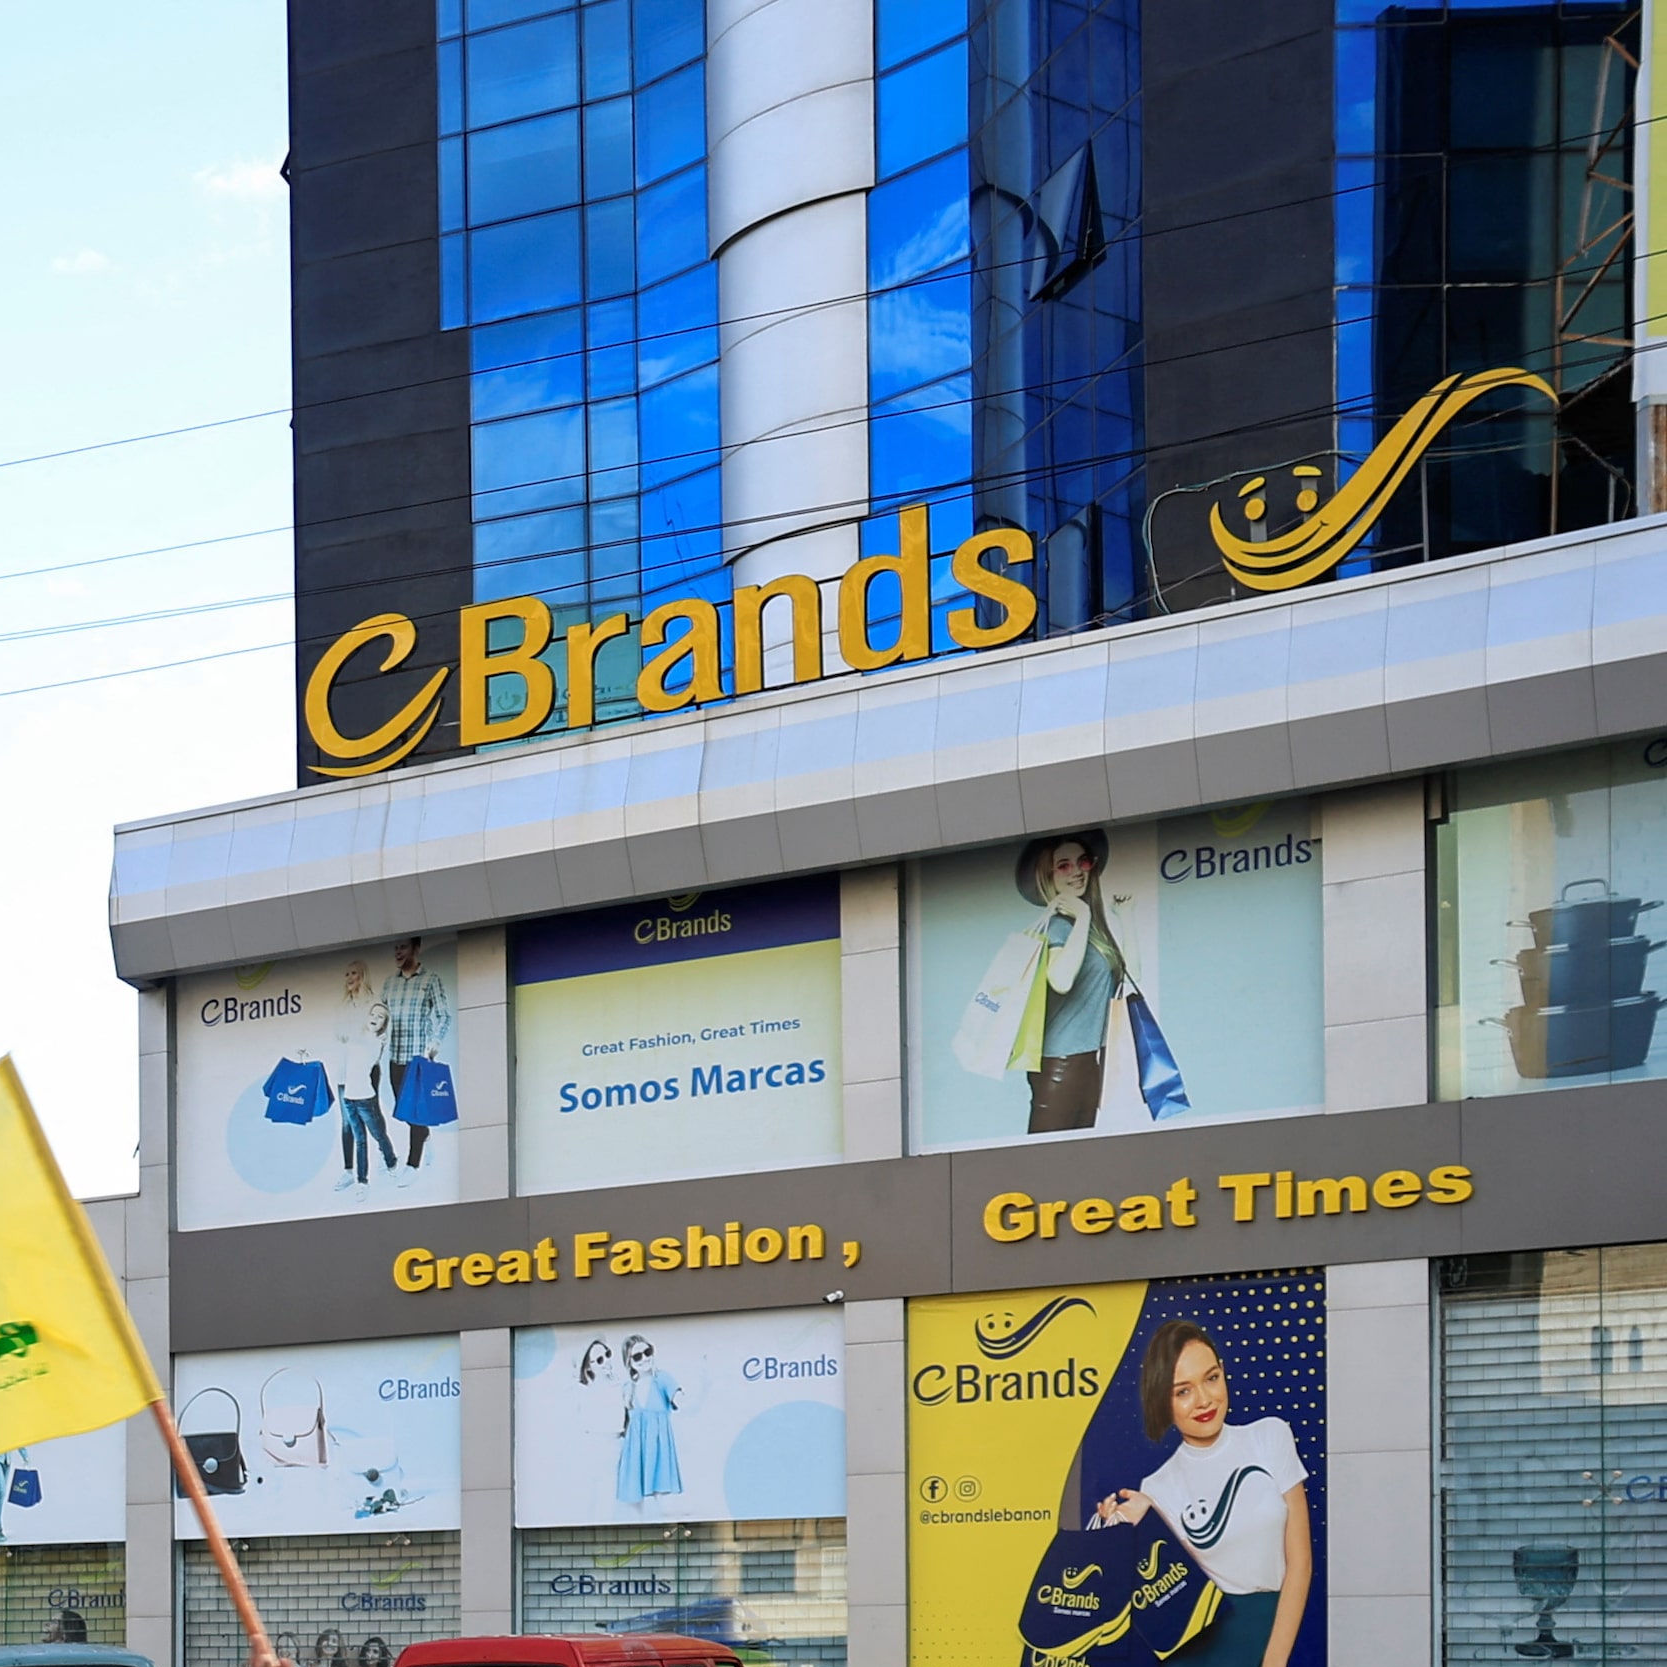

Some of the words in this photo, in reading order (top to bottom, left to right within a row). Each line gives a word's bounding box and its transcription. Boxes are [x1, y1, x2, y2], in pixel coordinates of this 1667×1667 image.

[581, 1040, 625, 1057] Great
[628, 1032, 696, 1053] Fashion,
[700, 1024, 744, 1043] Great
[749, 1016, 801, 1035] Times
[559, 1077, 680, 1114] Somos
[690, 1058, 826, 1099] Marcas
[983, 1177, 1197, 1243] Great
[1219, 1164, 1474, 1223] Times
[393, 1237, 558, 1293] Great
[920, 1508, 1051, 1525] @cbrandslebanon
